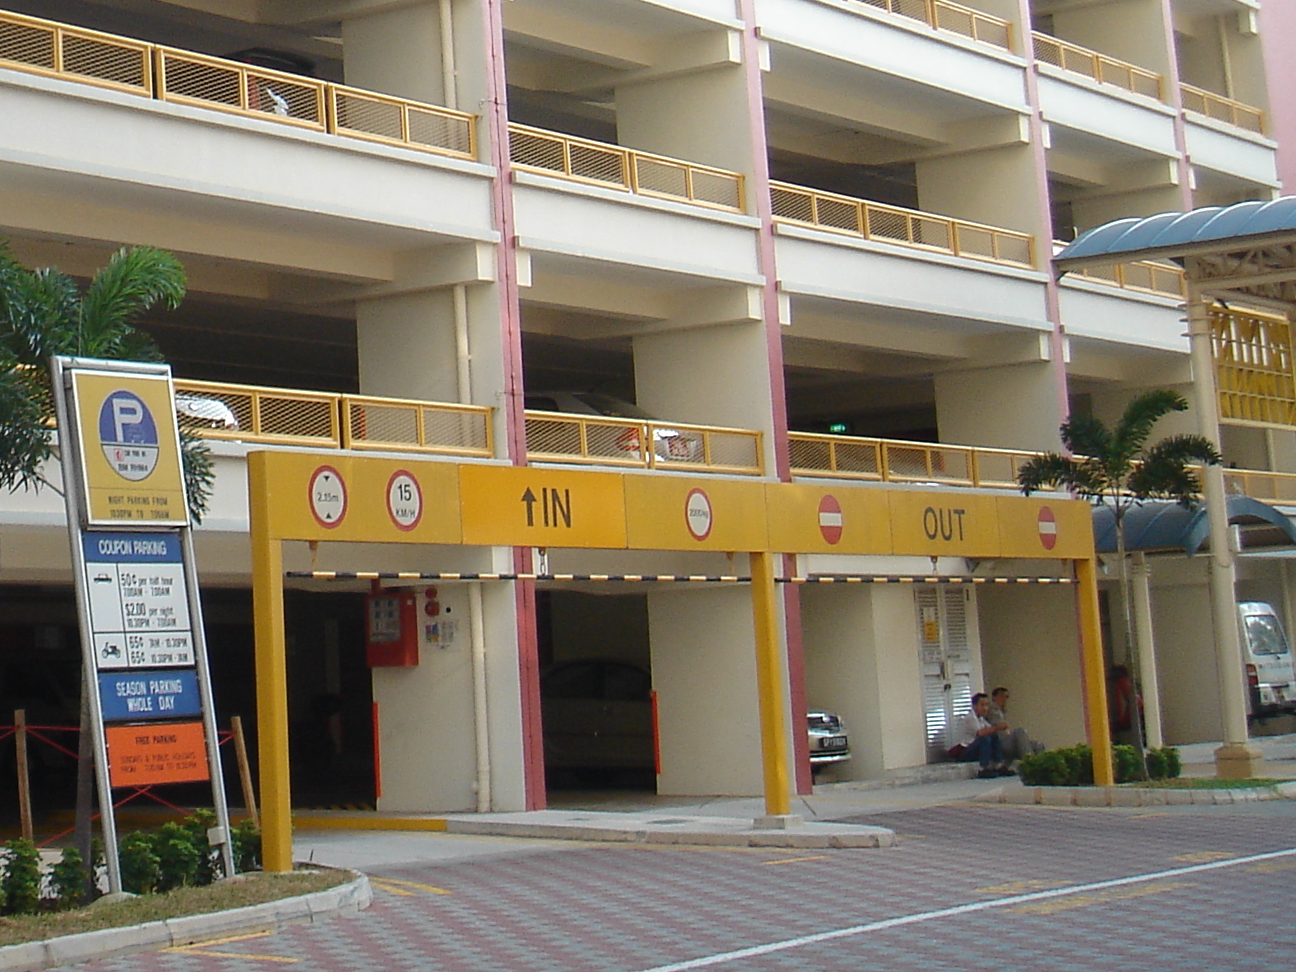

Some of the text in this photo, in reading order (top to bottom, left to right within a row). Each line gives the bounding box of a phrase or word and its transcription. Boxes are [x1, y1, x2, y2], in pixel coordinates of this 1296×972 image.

[112, 398, 143, 443] P
[108, 495, 168, 505] NIGHT PARKING FROM
[397, 483, 412, 502] 15
[396, 508, 416, 518] KM/H
[542, 487, 572, 528] IN
[923, 506, 966, 541] OUT
[98, 539, 167, 555] COUPON PARKING
[125, 602, 146, 616] $2.00
[116, 679, 182, 696] SEASON PARKING
[127, 695, 174, 712] WHOLE DAY
[135, 734, 177, 744] FREE PARKING
